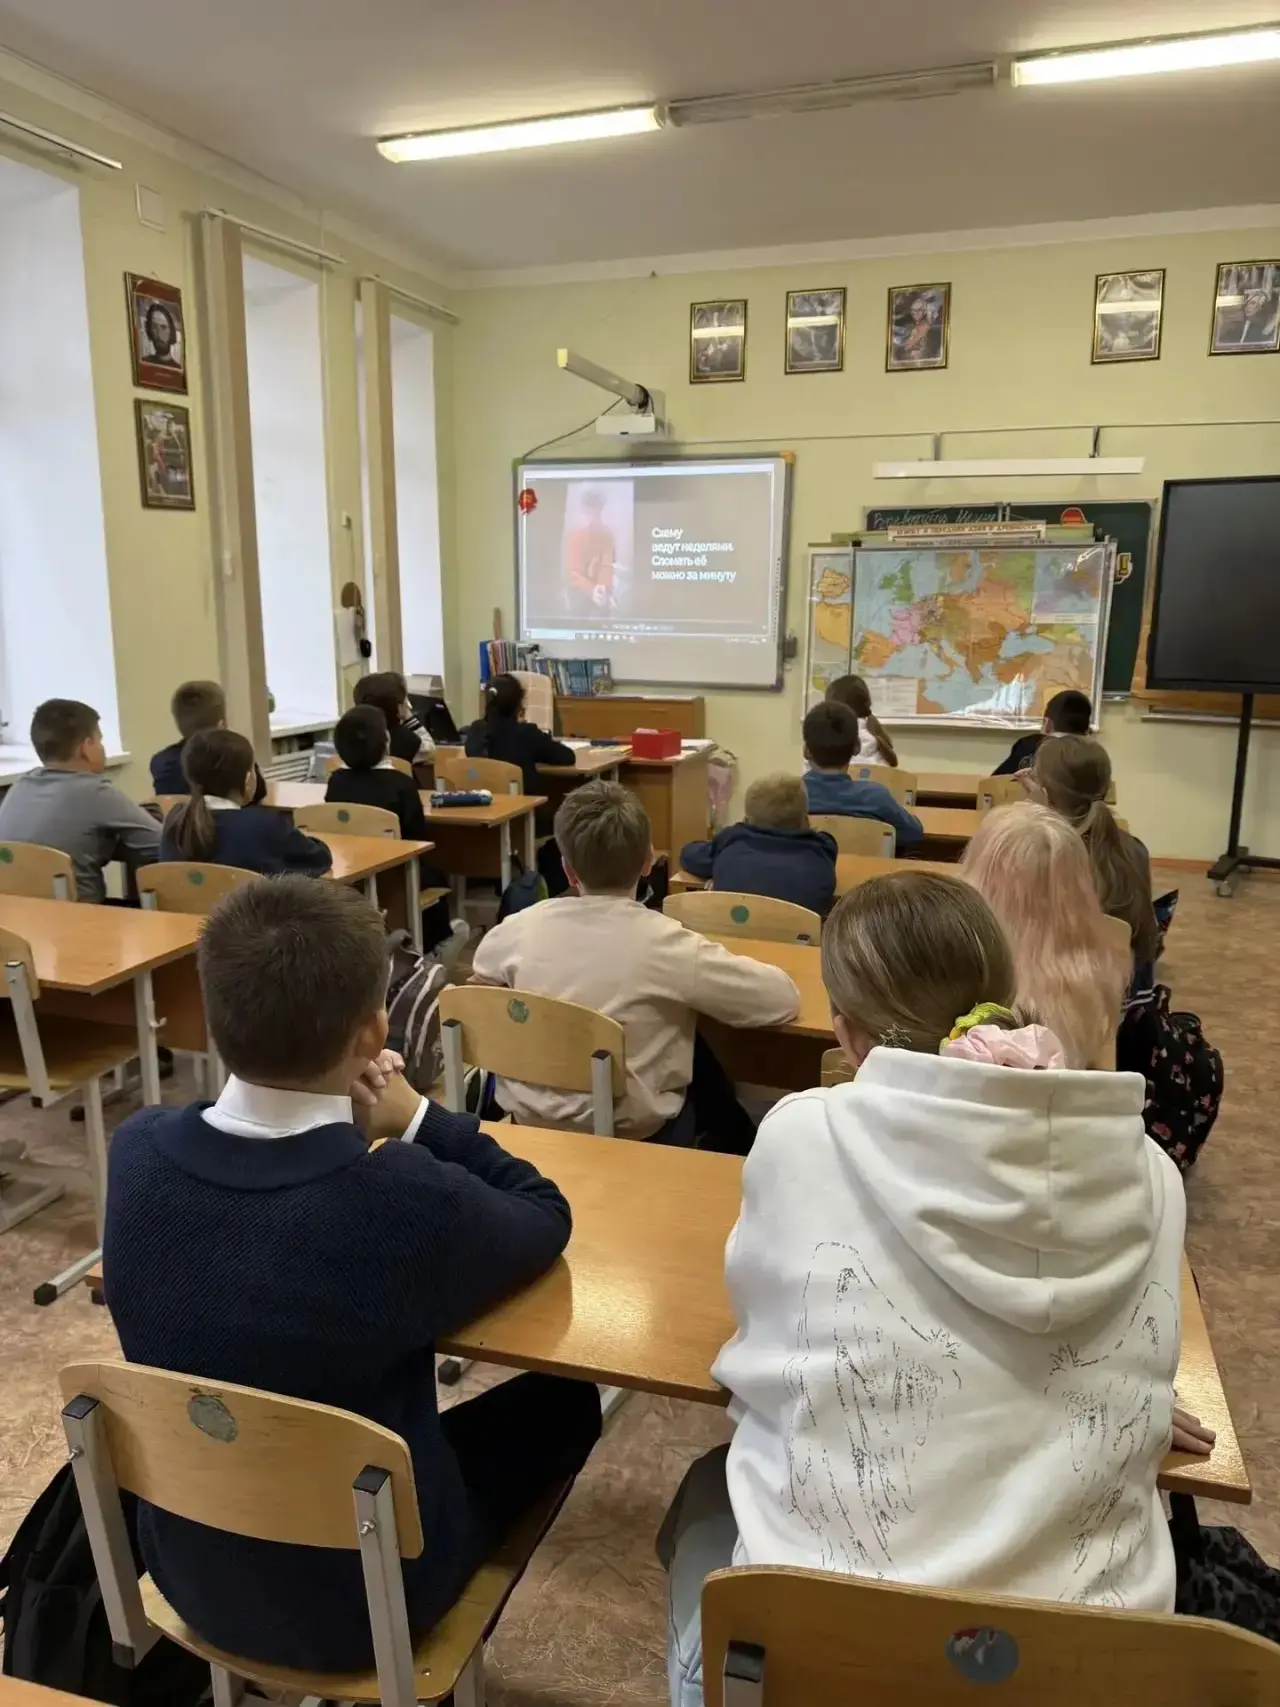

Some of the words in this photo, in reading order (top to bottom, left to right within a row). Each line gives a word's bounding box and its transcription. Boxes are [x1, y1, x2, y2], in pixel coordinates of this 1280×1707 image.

[651, 542, 680, 554] ведут
[651, 555, 693, 566] Сломать
[694, 554, 708, 566] её
[651, 571, 686, 580] можно
[686, 571, 698, 580] за
[699, 571, 736, 583] минуту
